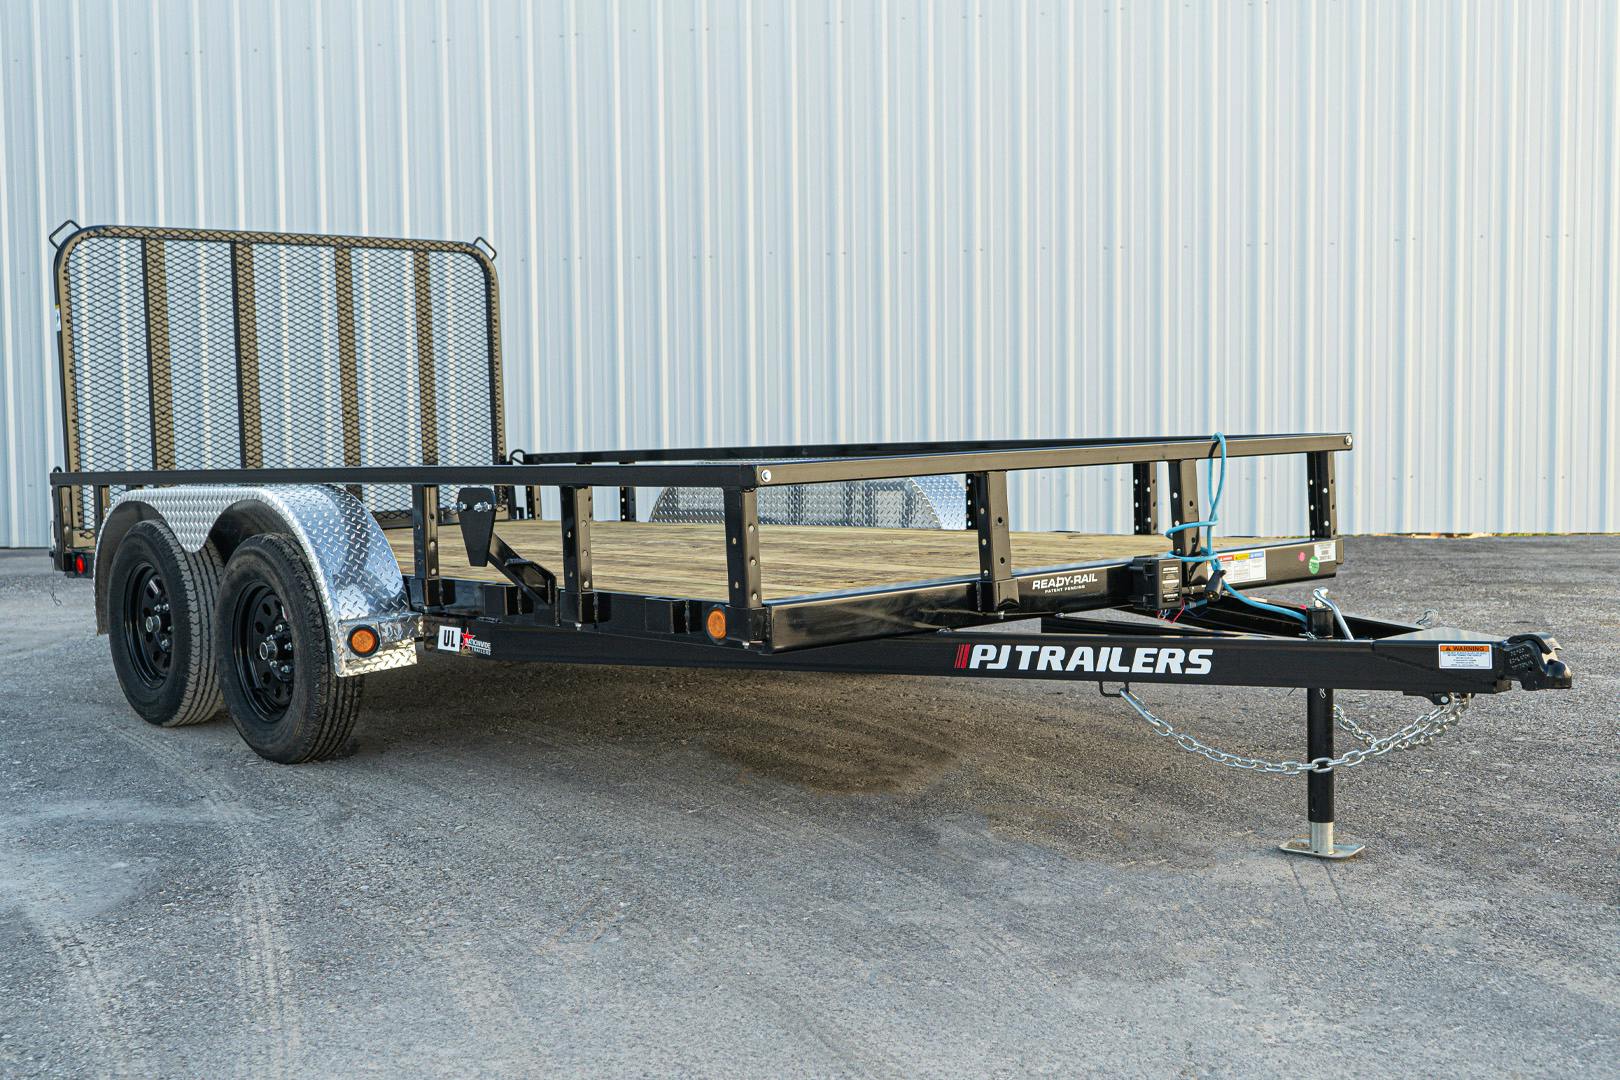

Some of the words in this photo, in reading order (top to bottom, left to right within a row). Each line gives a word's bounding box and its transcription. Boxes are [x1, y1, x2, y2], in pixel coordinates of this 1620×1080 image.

[444, 630, 456, 647] UL
[969, 644, 1011, 670] PJ
[1015, 645, 1214, 675] TRAILERS
